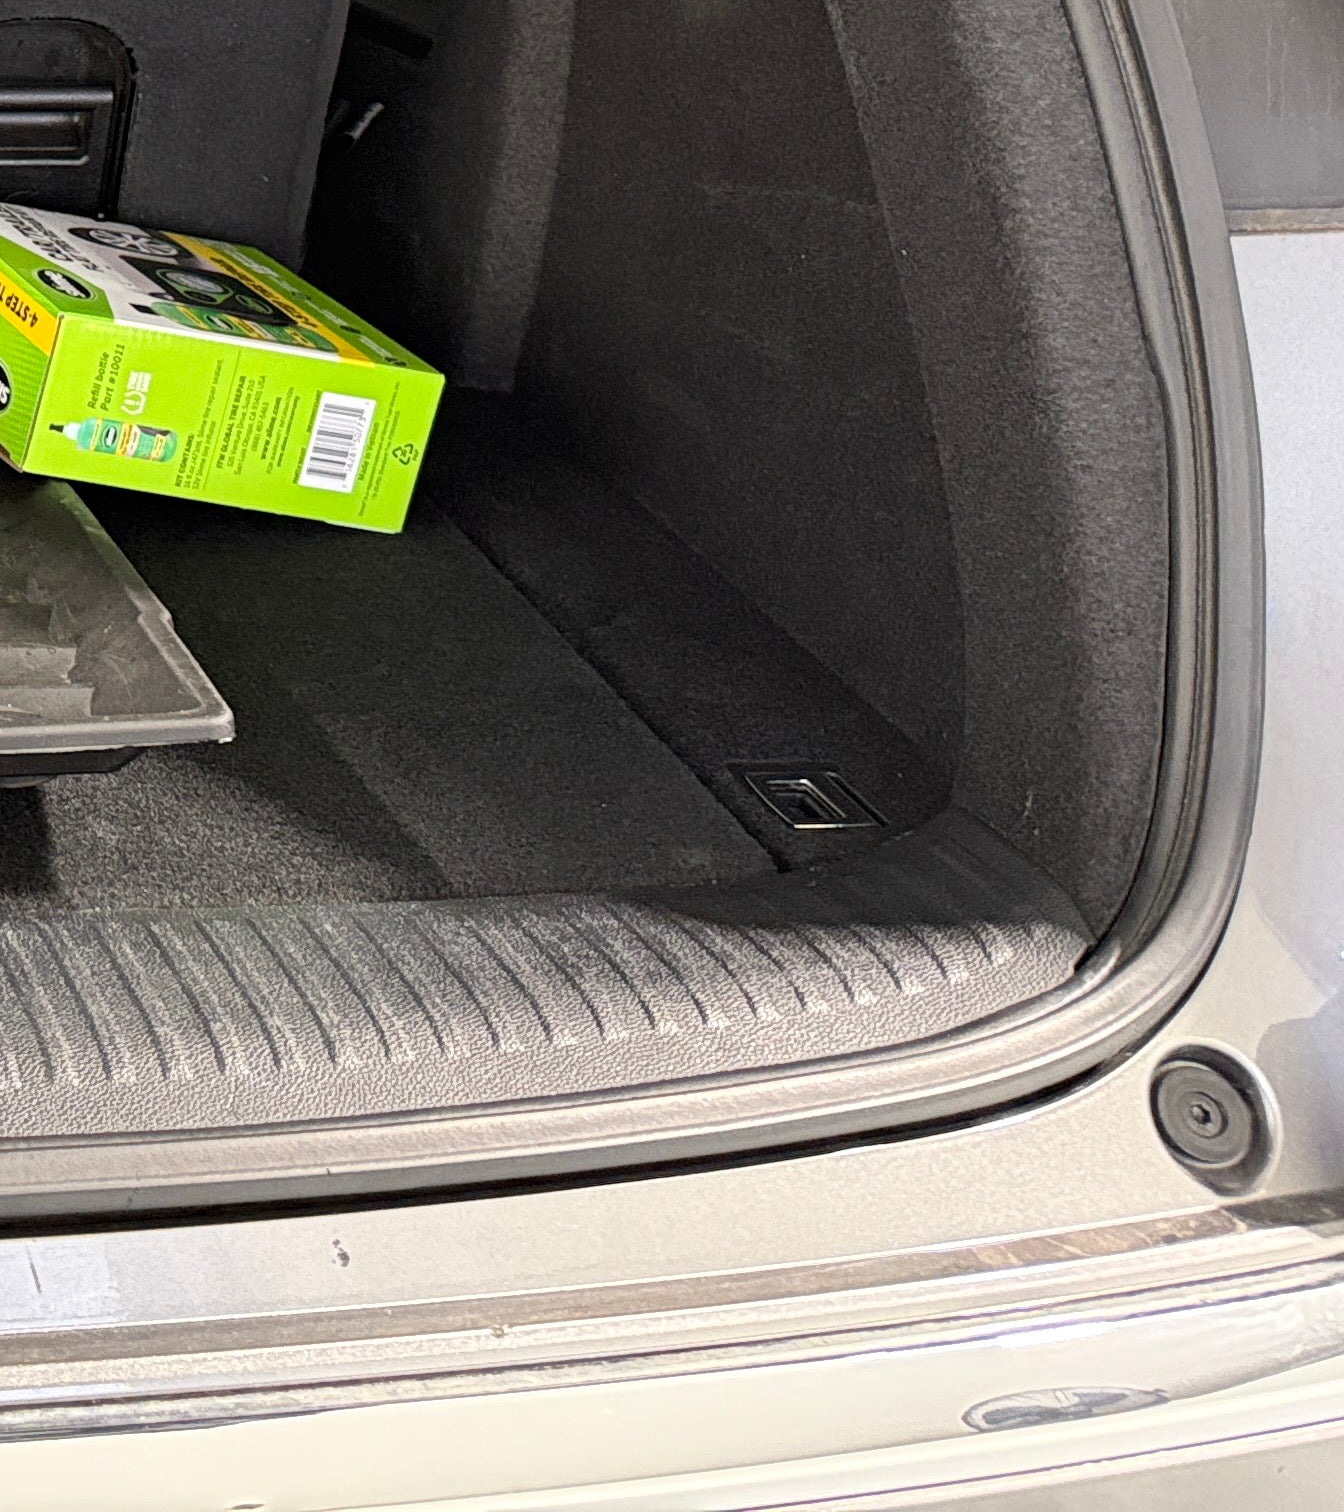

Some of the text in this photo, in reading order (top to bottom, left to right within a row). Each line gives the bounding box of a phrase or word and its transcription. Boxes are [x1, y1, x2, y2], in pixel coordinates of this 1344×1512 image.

[5, 292, 38, 328] 4-STEP
[87, 352, 109, 409] Refill bottle
[100, 344, 125, 411] Part #10011
